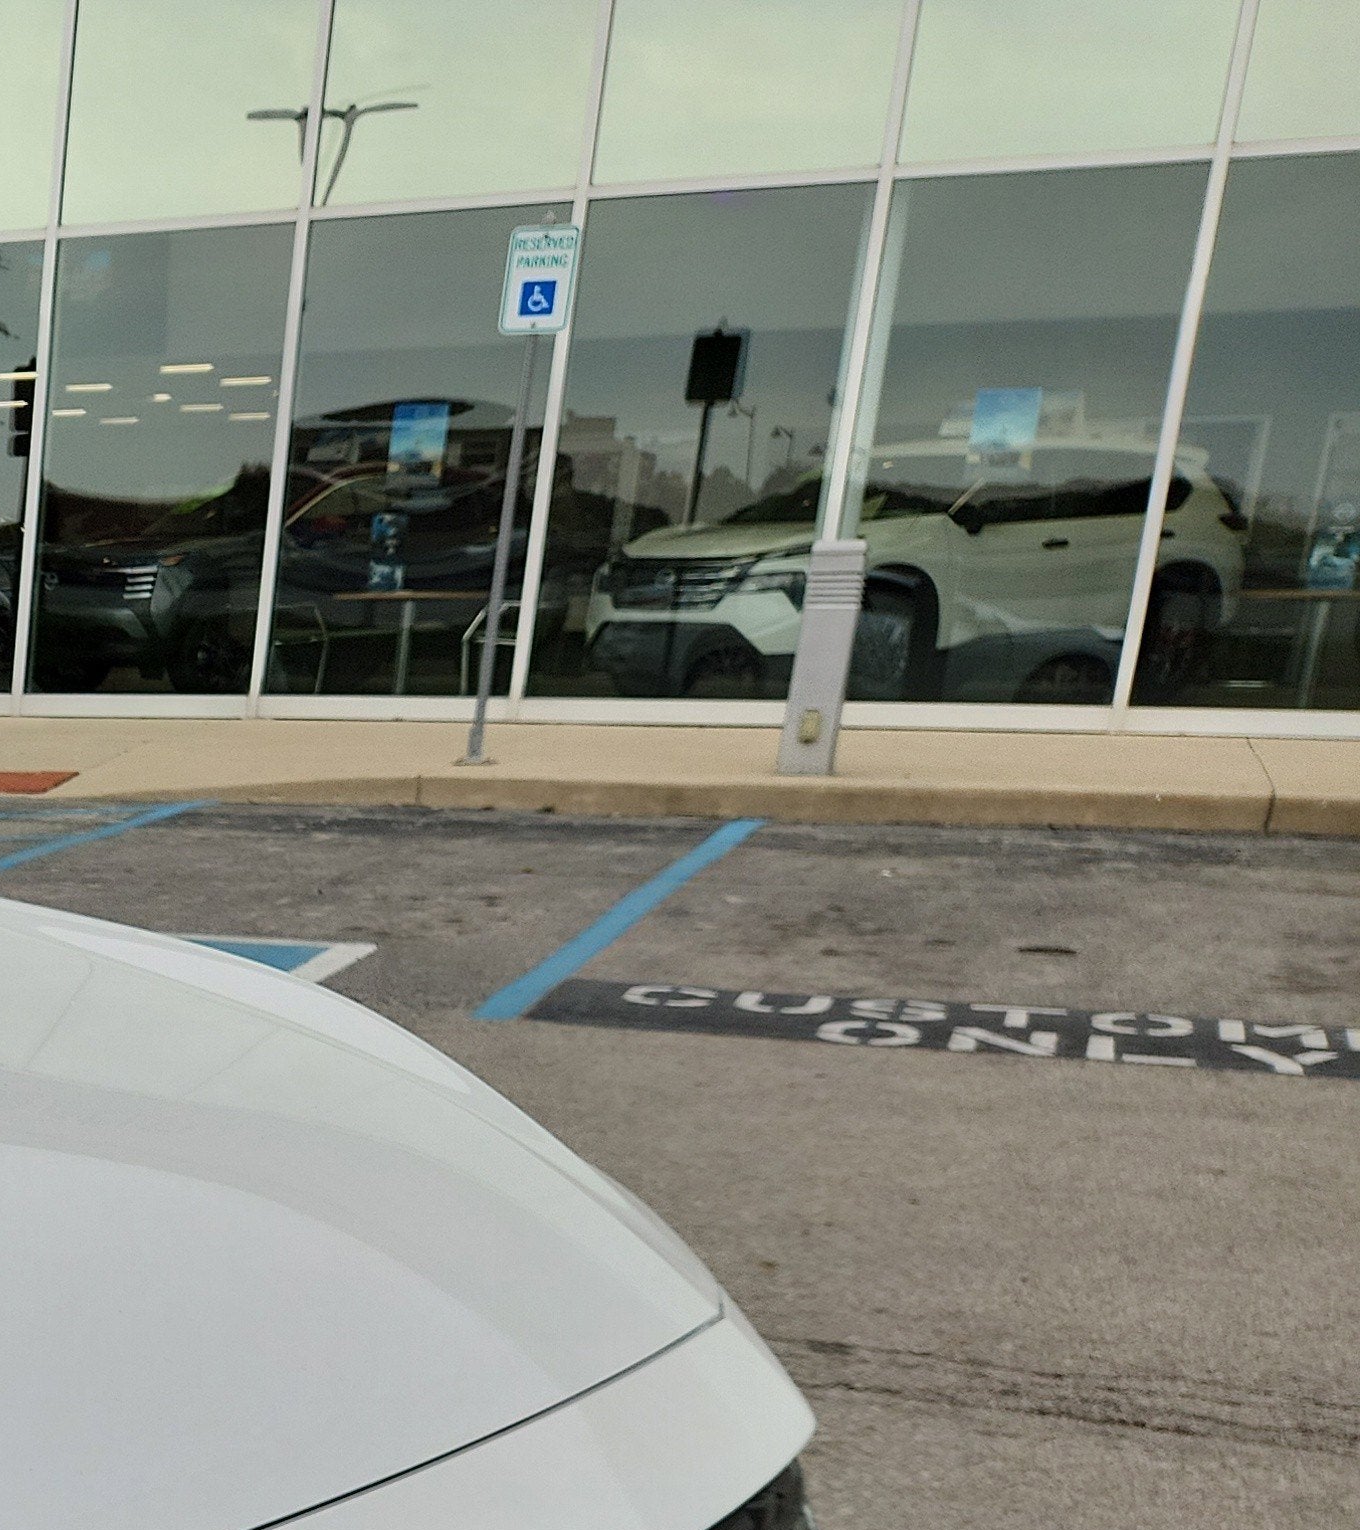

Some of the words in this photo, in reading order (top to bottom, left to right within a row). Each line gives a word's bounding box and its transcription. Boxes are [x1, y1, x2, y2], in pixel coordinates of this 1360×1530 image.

[515, 236, 574, 250] RESERVED
[517, 253, 568, 268] PARKING
[625, 984, 1360, 1050] CUSTOM
[815, 1020, 1340, 1076] ONLY
